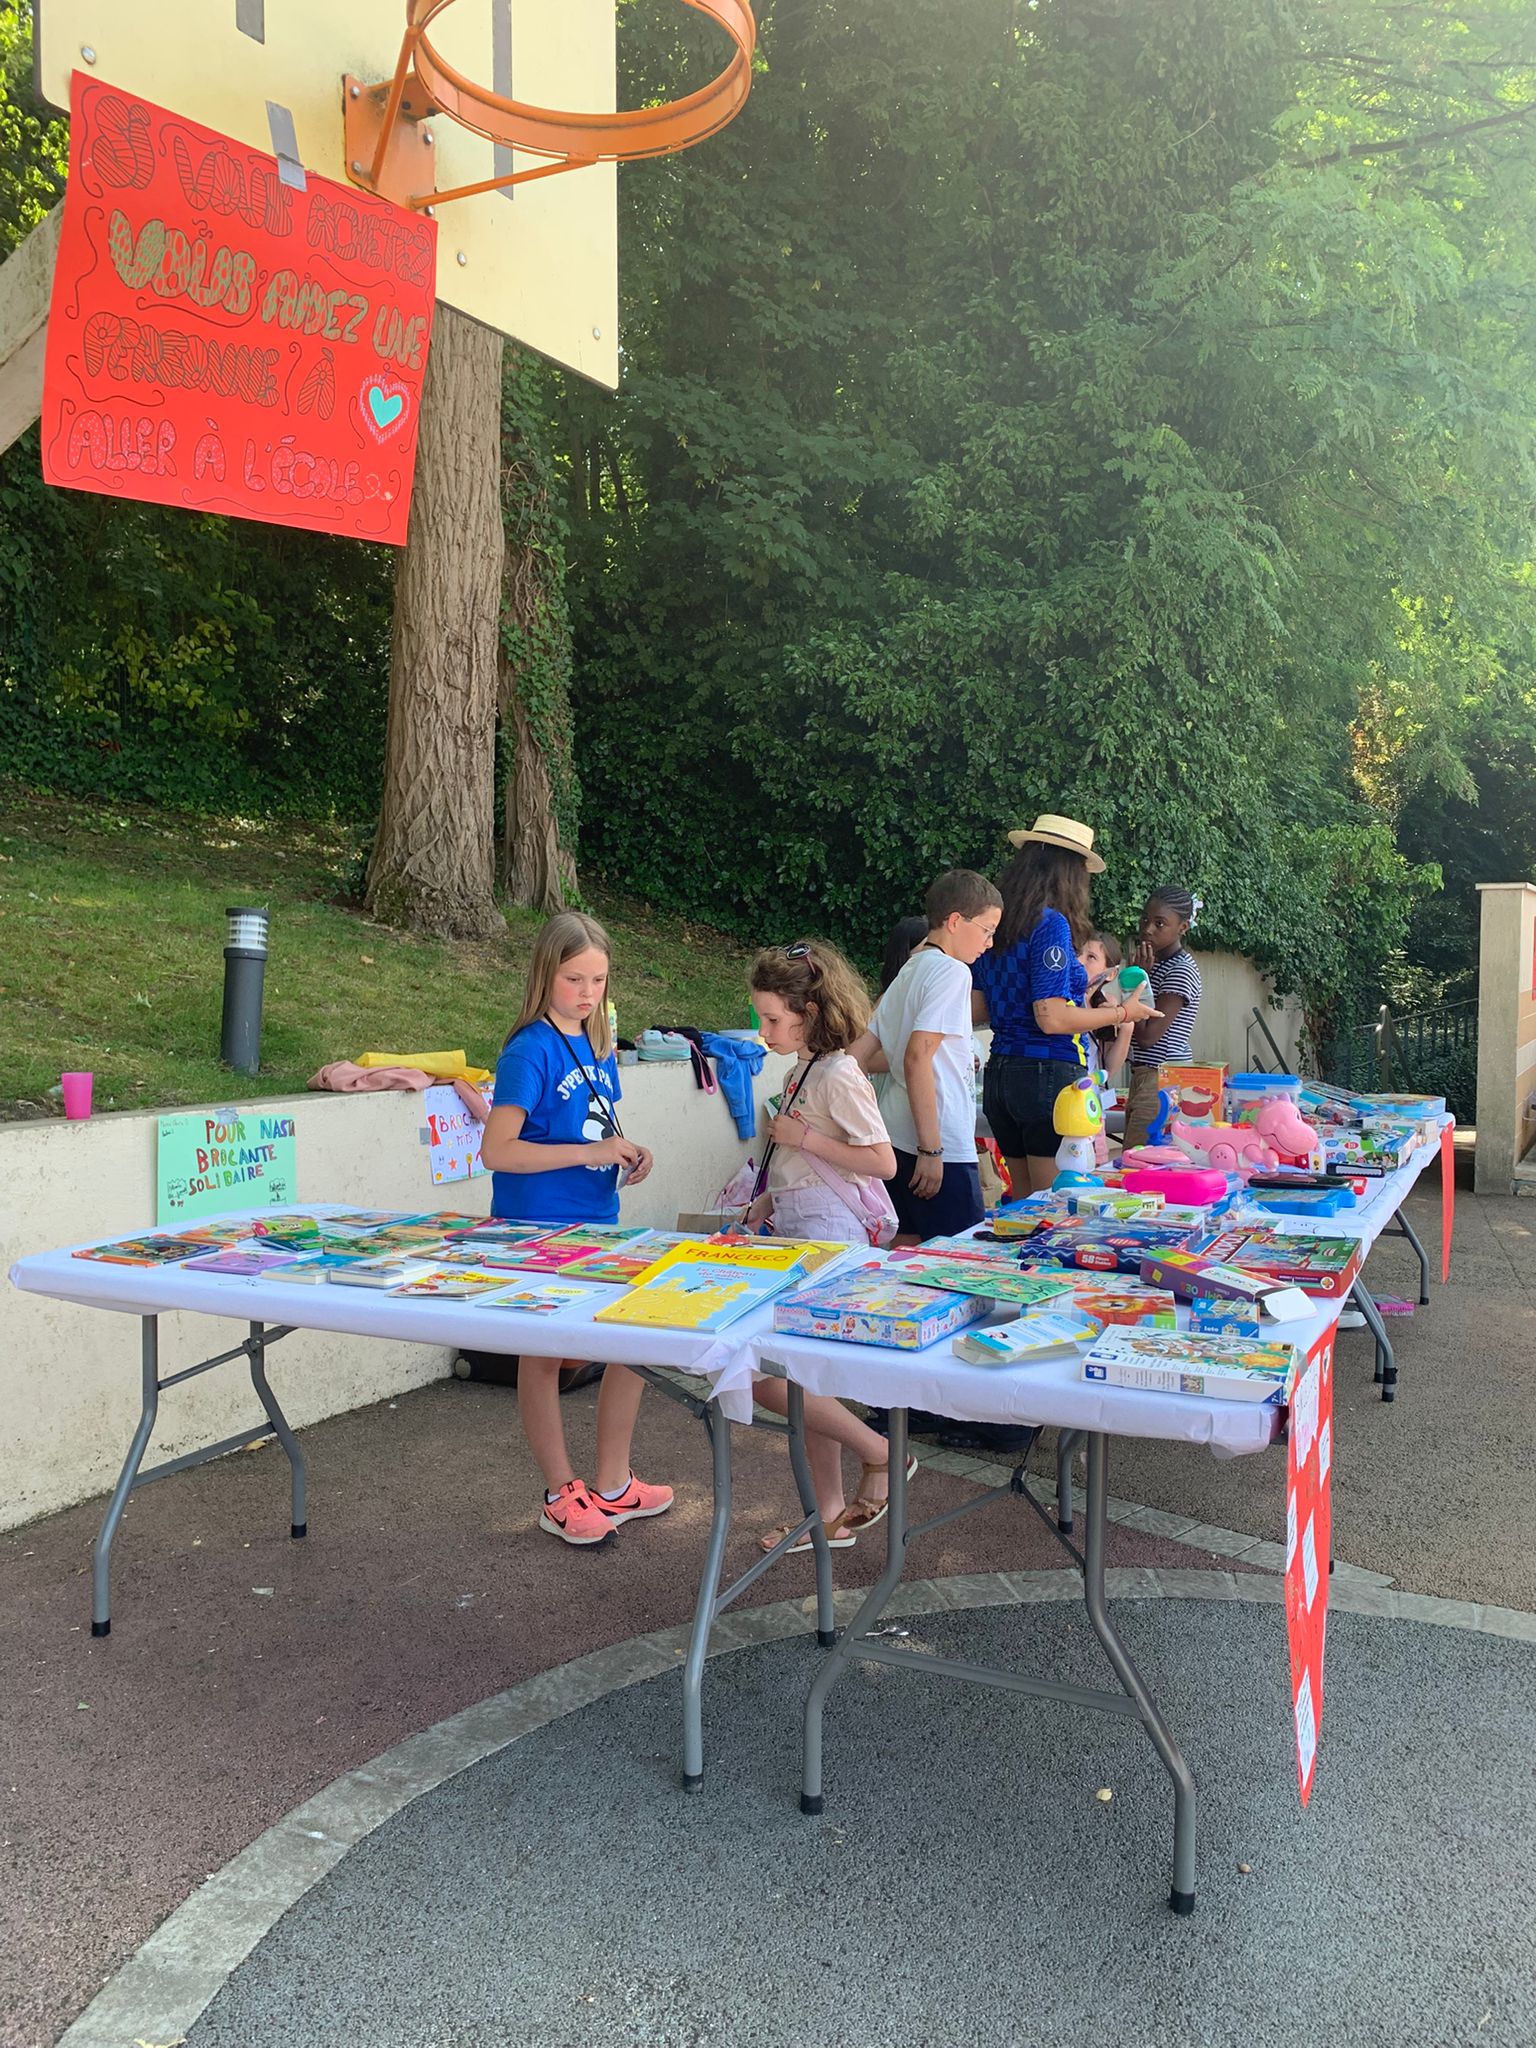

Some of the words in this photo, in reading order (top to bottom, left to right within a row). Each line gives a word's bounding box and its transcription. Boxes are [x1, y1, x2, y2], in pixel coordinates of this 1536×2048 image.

[173, 135, 293, 237] VOUS
[306, 193, 433, 288] ACHETEZ
[108, 208, 257, 316] VOUS
[261, 269, 369, 344] AIDEZ
[372, 303, 428, 371] UNE
[83, 312, 280, 407] PERSONNE
[67, 409, 178, 477] ALLER
[193, 416, 226, 482] À
[597, 1068, 614, 1095] PA
[205, 1120, 246, 1144] POUR
[196, 1144, 277, 1174] BROCANTE
[188, 1164, 264, 1196] SOLIDAIRE
[685, 1248, 788, 1262] FRANCISCO
